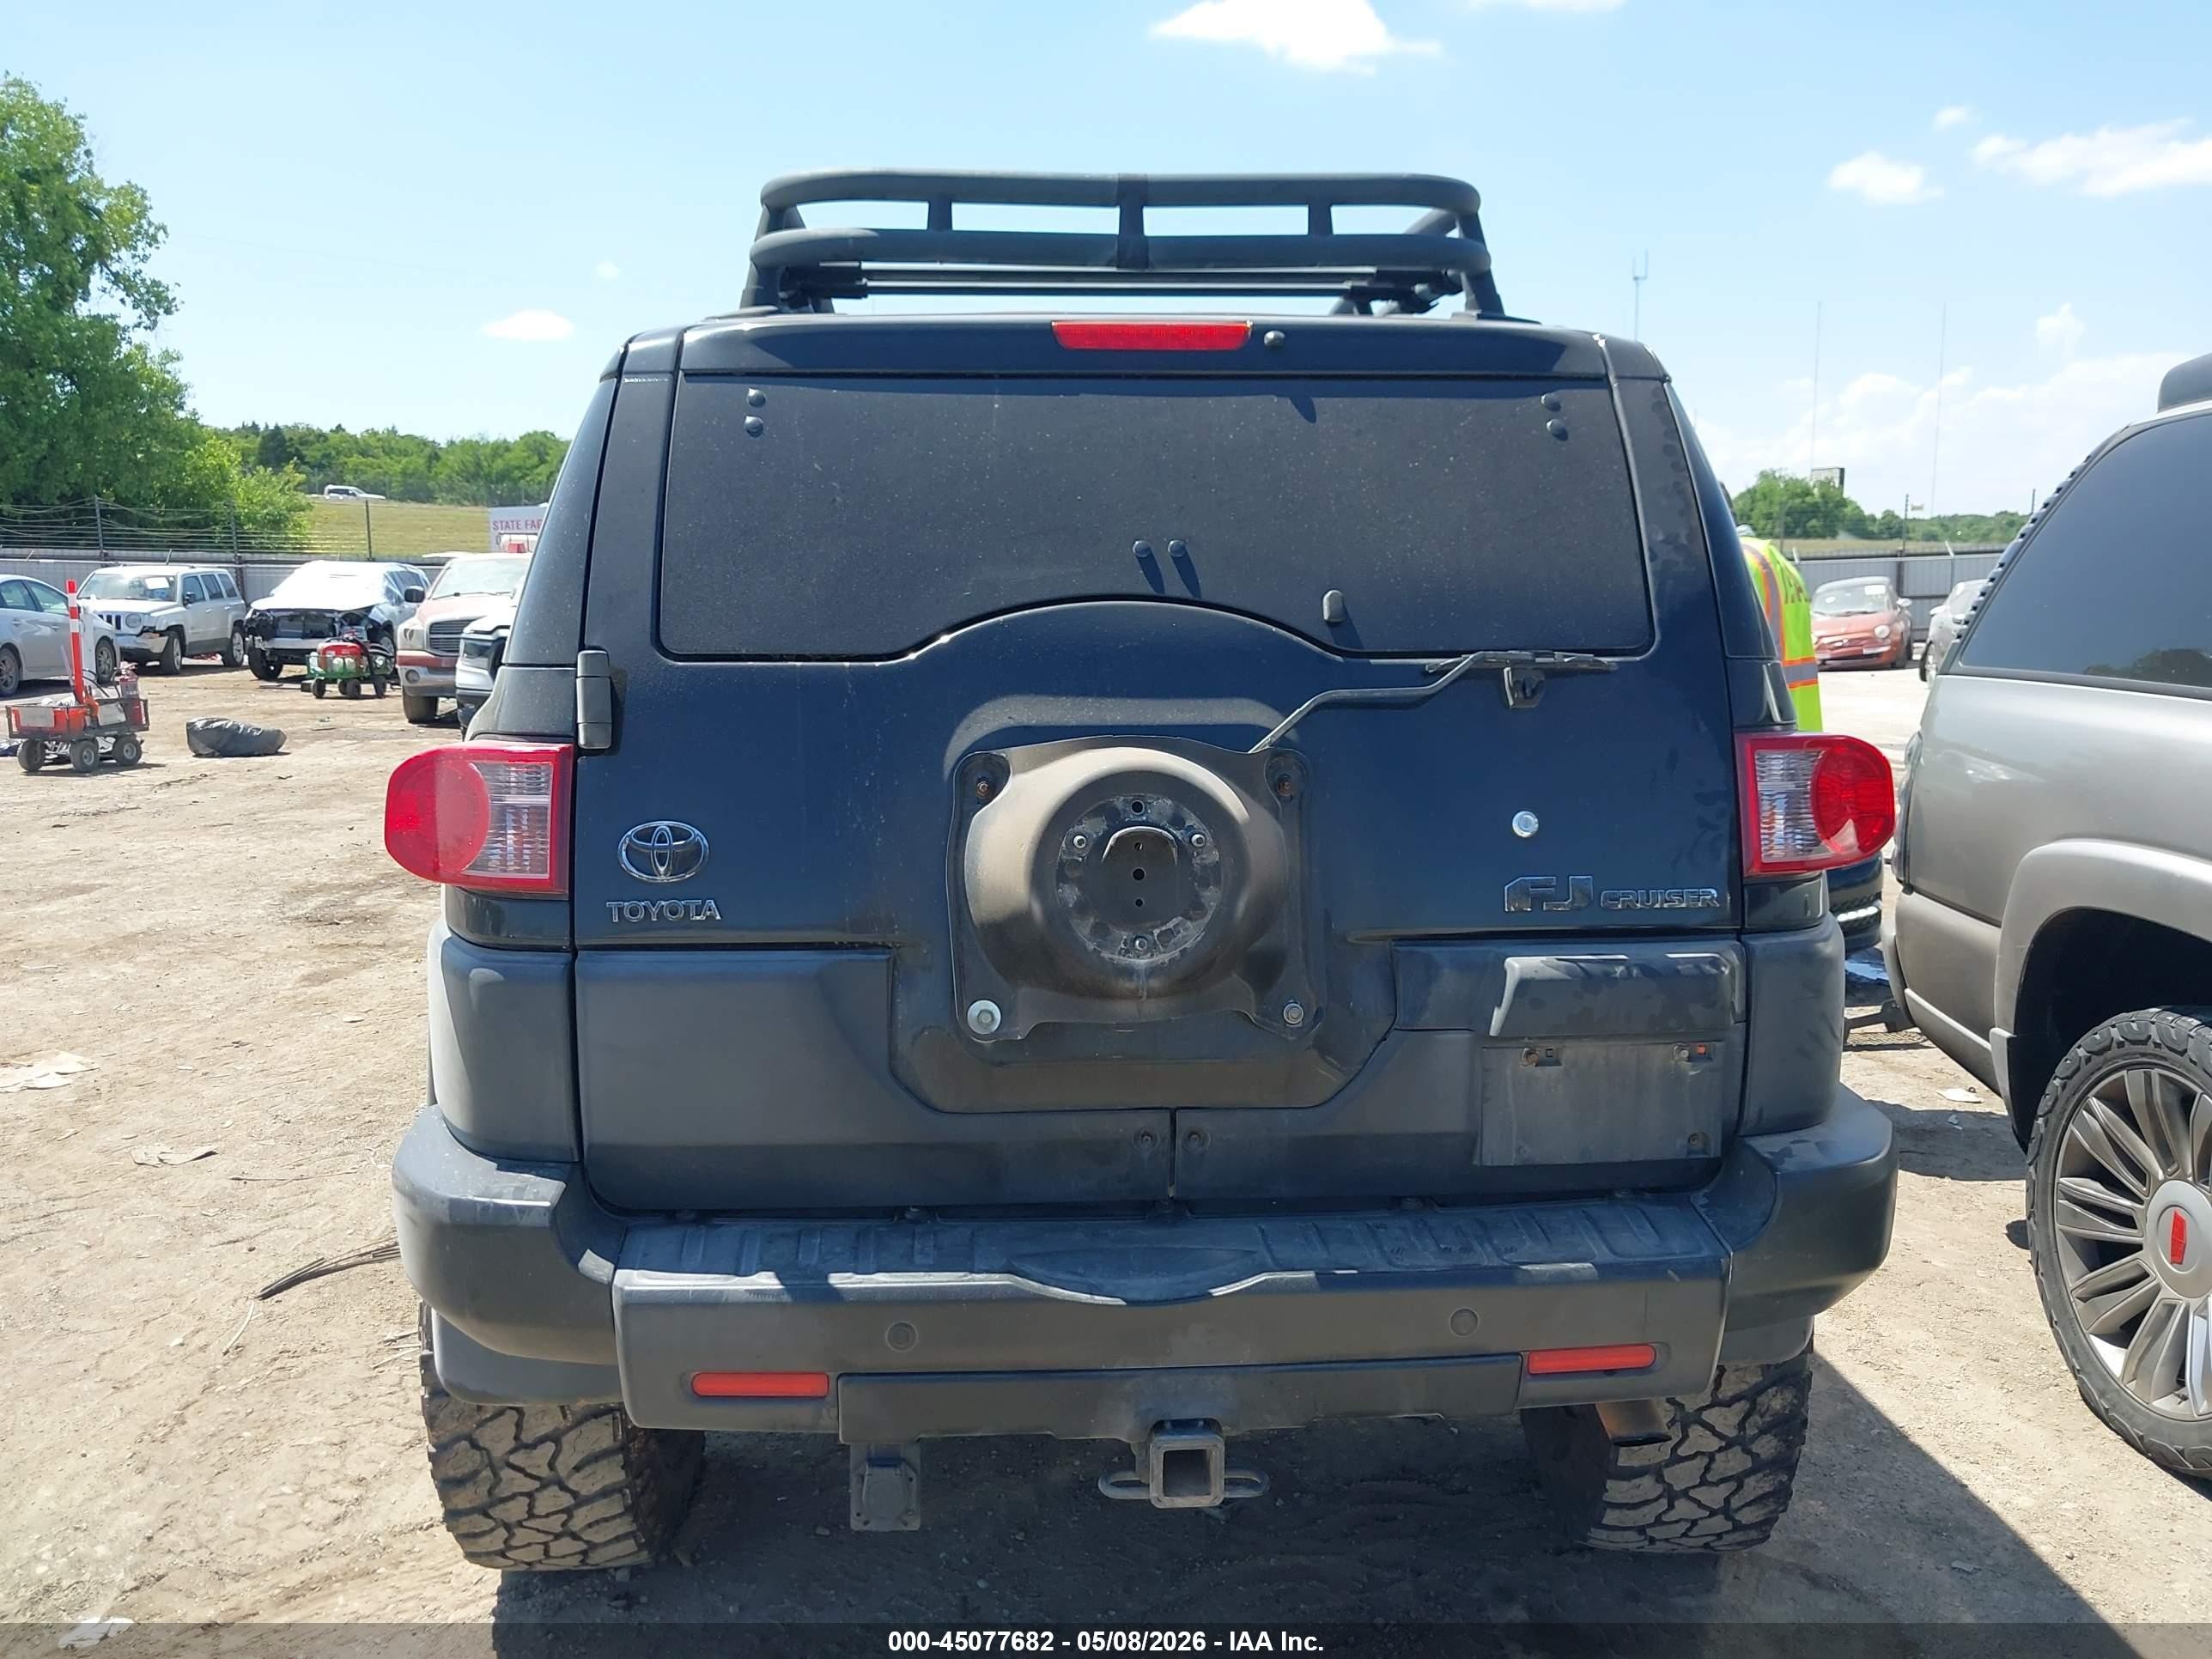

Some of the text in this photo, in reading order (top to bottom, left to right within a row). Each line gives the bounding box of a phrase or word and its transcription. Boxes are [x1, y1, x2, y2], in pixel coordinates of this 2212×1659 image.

[492, 519, 522, 531] STATE
[1504, 875, 1720, 912] FJ CRUISER
[605, 900, 721, 922] TOYOTA
